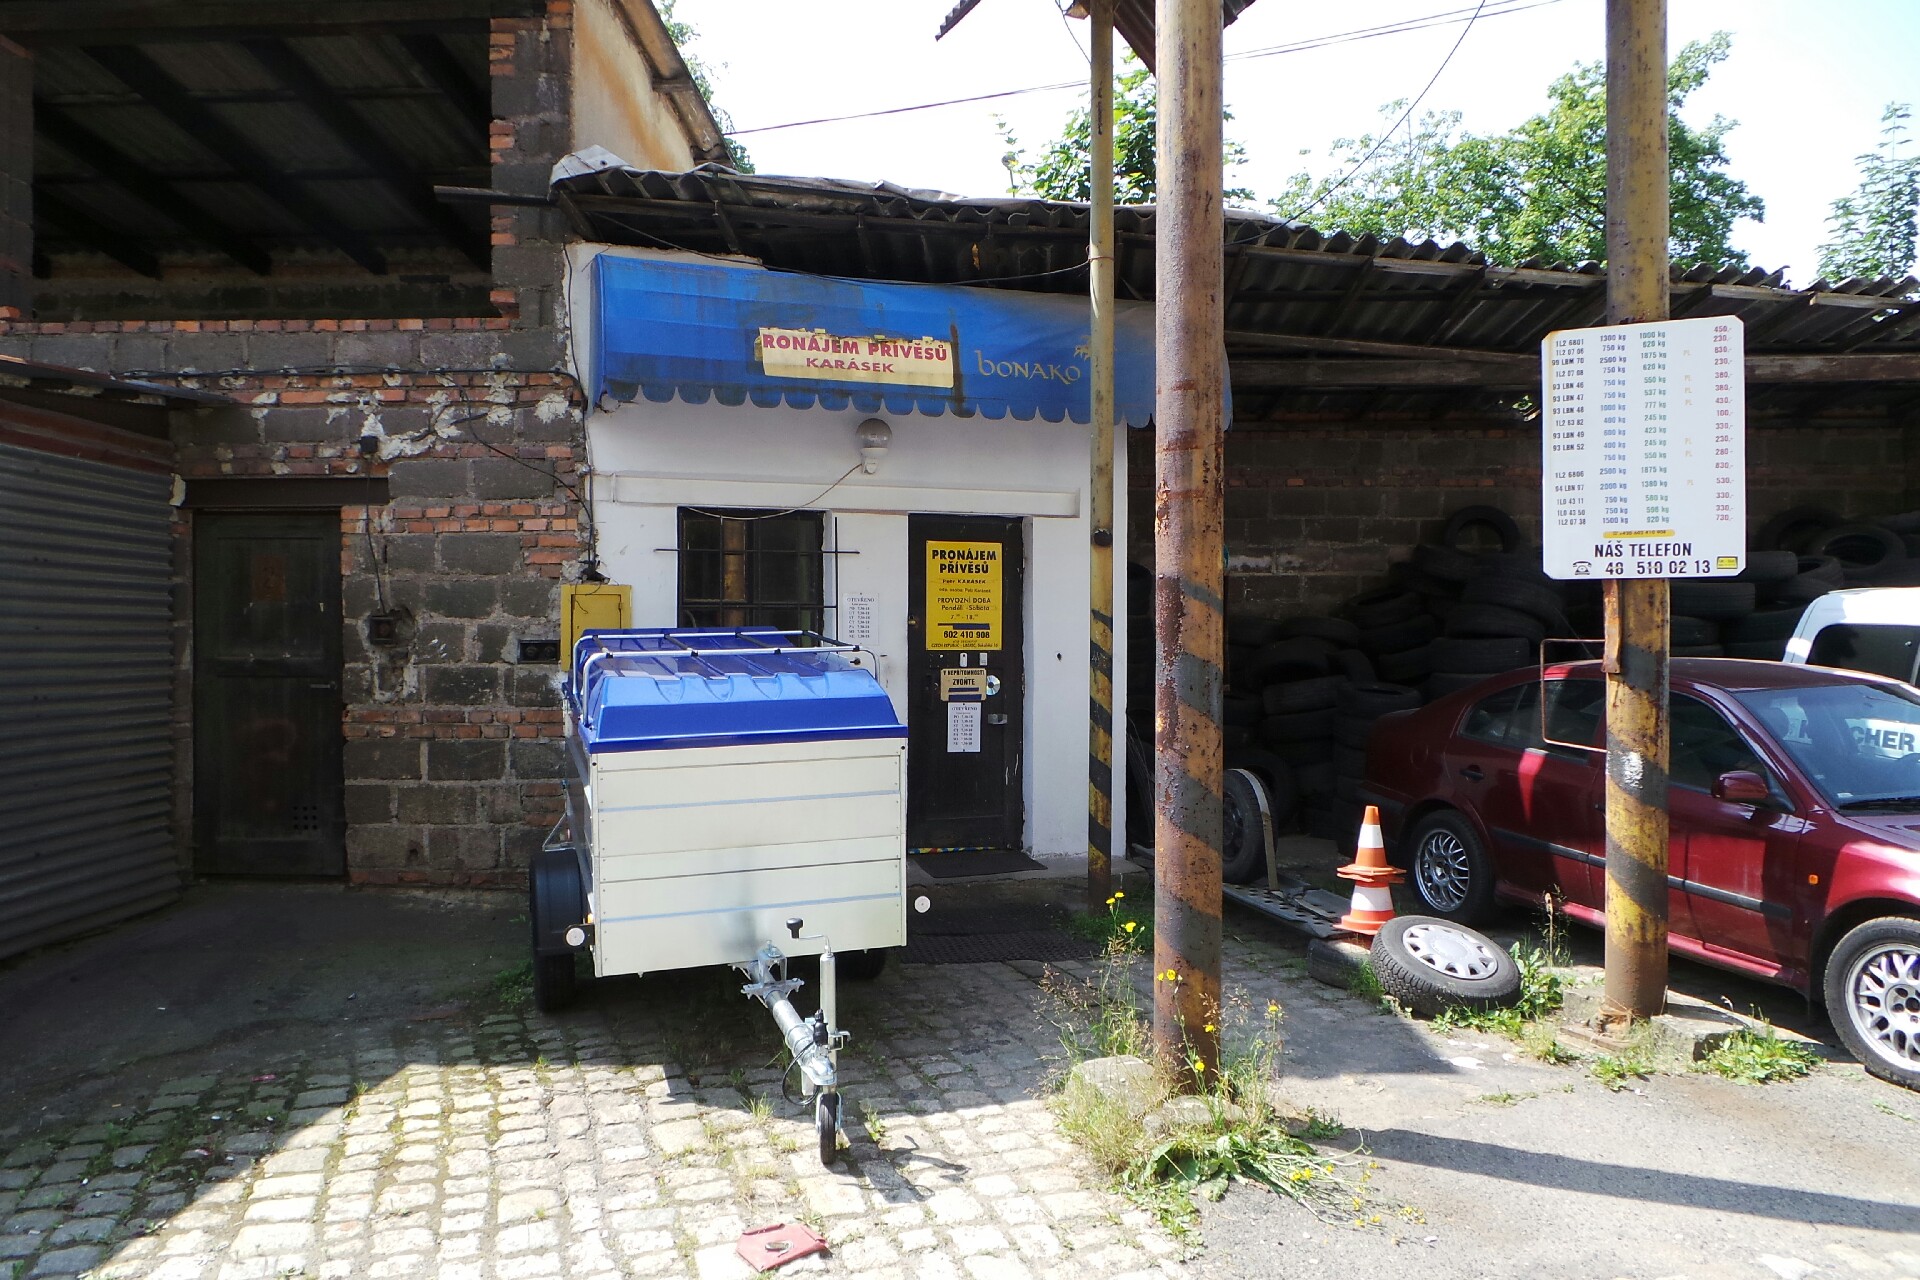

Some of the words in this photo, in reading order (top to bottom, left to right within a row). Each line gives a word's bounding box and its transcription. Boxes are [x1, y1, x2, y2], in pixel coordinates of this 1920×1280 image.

[762, 334, 860, 354] RONÁJEM
[806, 358, 894, 373] KARÁSEK
[932, 548, 996, 560] PRONÁJEM
[1594, 540, 1623, 558] NÁŠ
[1629, 543, 1692, 557] TELEFON
[940, 561, 988, 573] PŘÍVĚSŮ
[1695, 560, 1710, 573] 13
[1849, 726, 1915, 752] CHER
